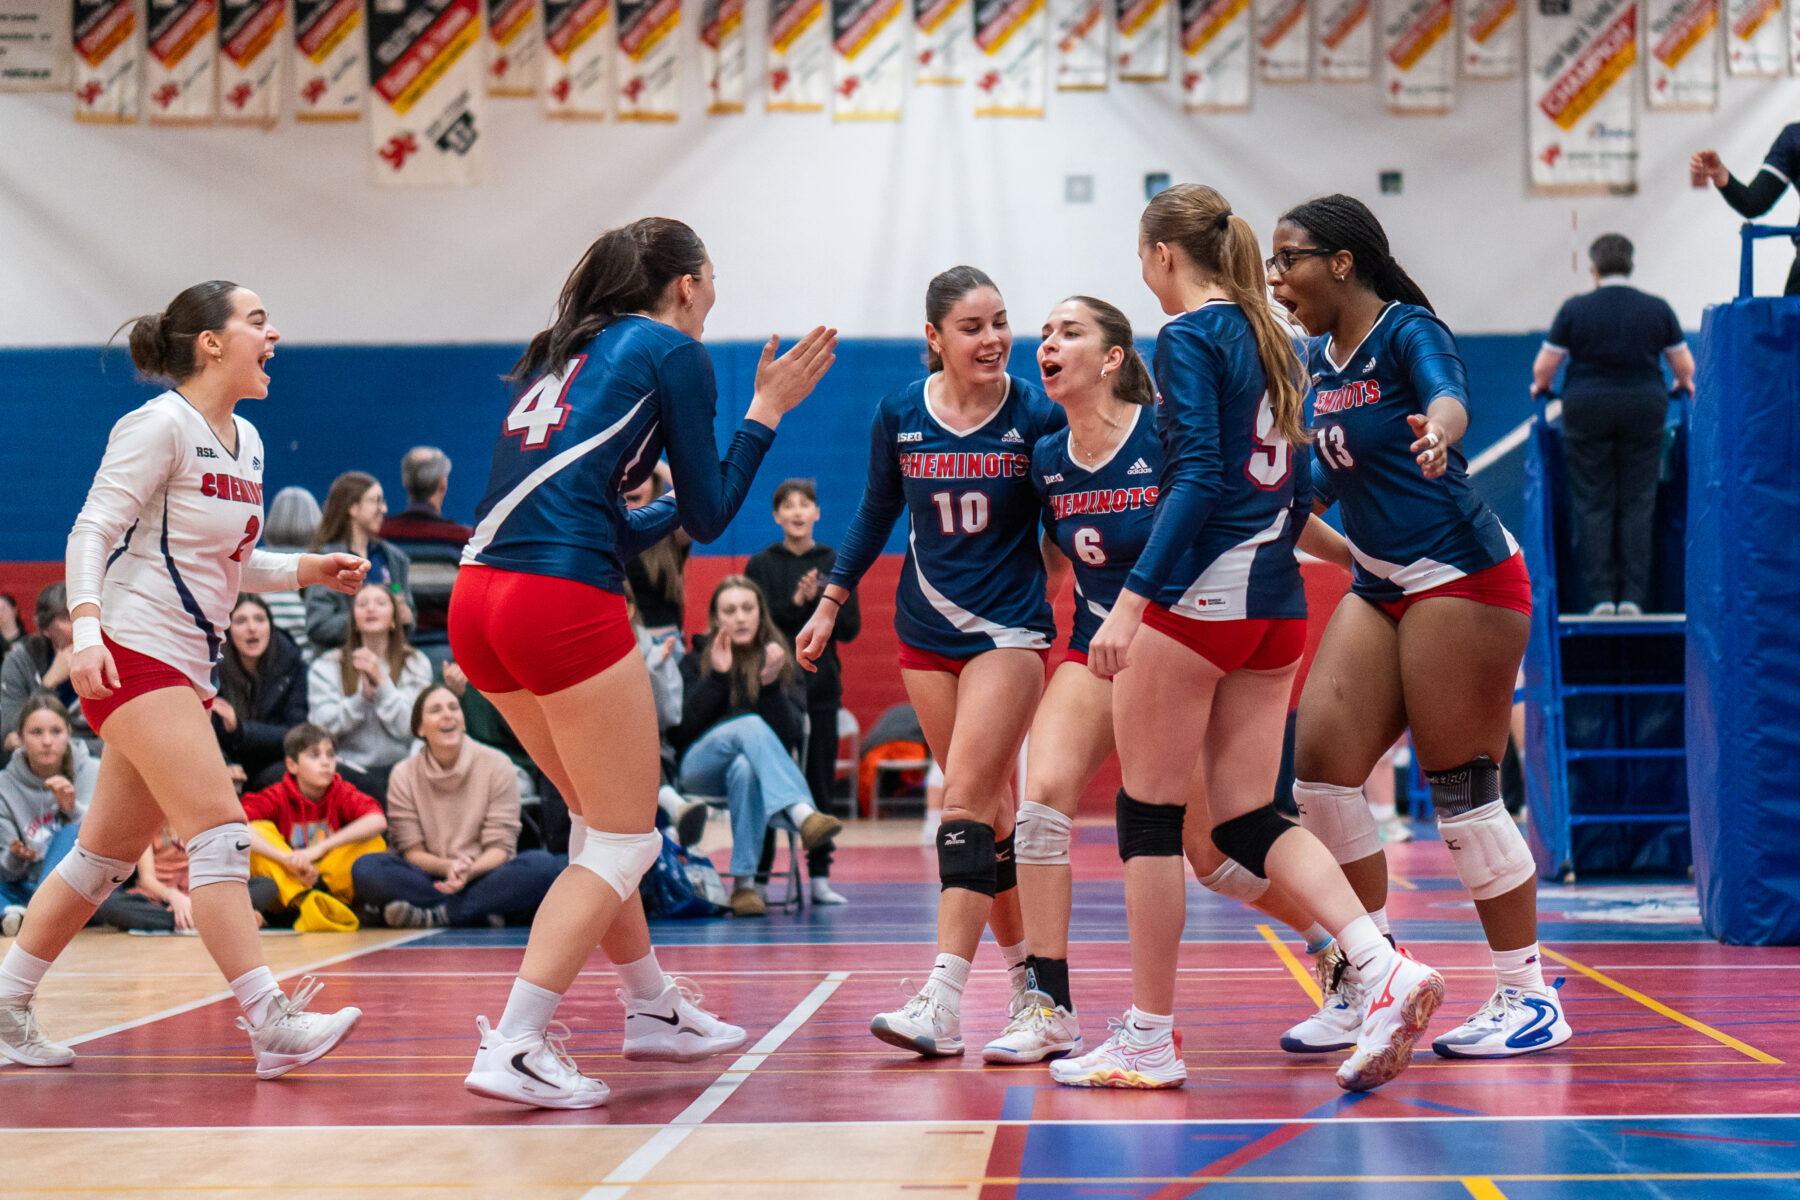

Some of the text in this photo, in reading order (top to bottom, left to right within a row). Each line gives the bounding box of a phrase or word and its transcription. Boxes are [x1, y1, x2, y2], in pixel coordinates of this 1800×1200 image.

[503, 354, 588, 451] 4
[195, 446, 219, 459] RSE
[1316, 424, 1356, 470] 13
[1127, 467, 1153, 475] adidas
[931, 490, 991, 536] 10
[1049, 486, 1160, 520] HEMINOTS
[228, 515, 260, 562] 2
[1072, 525, 1108, 567] 6
